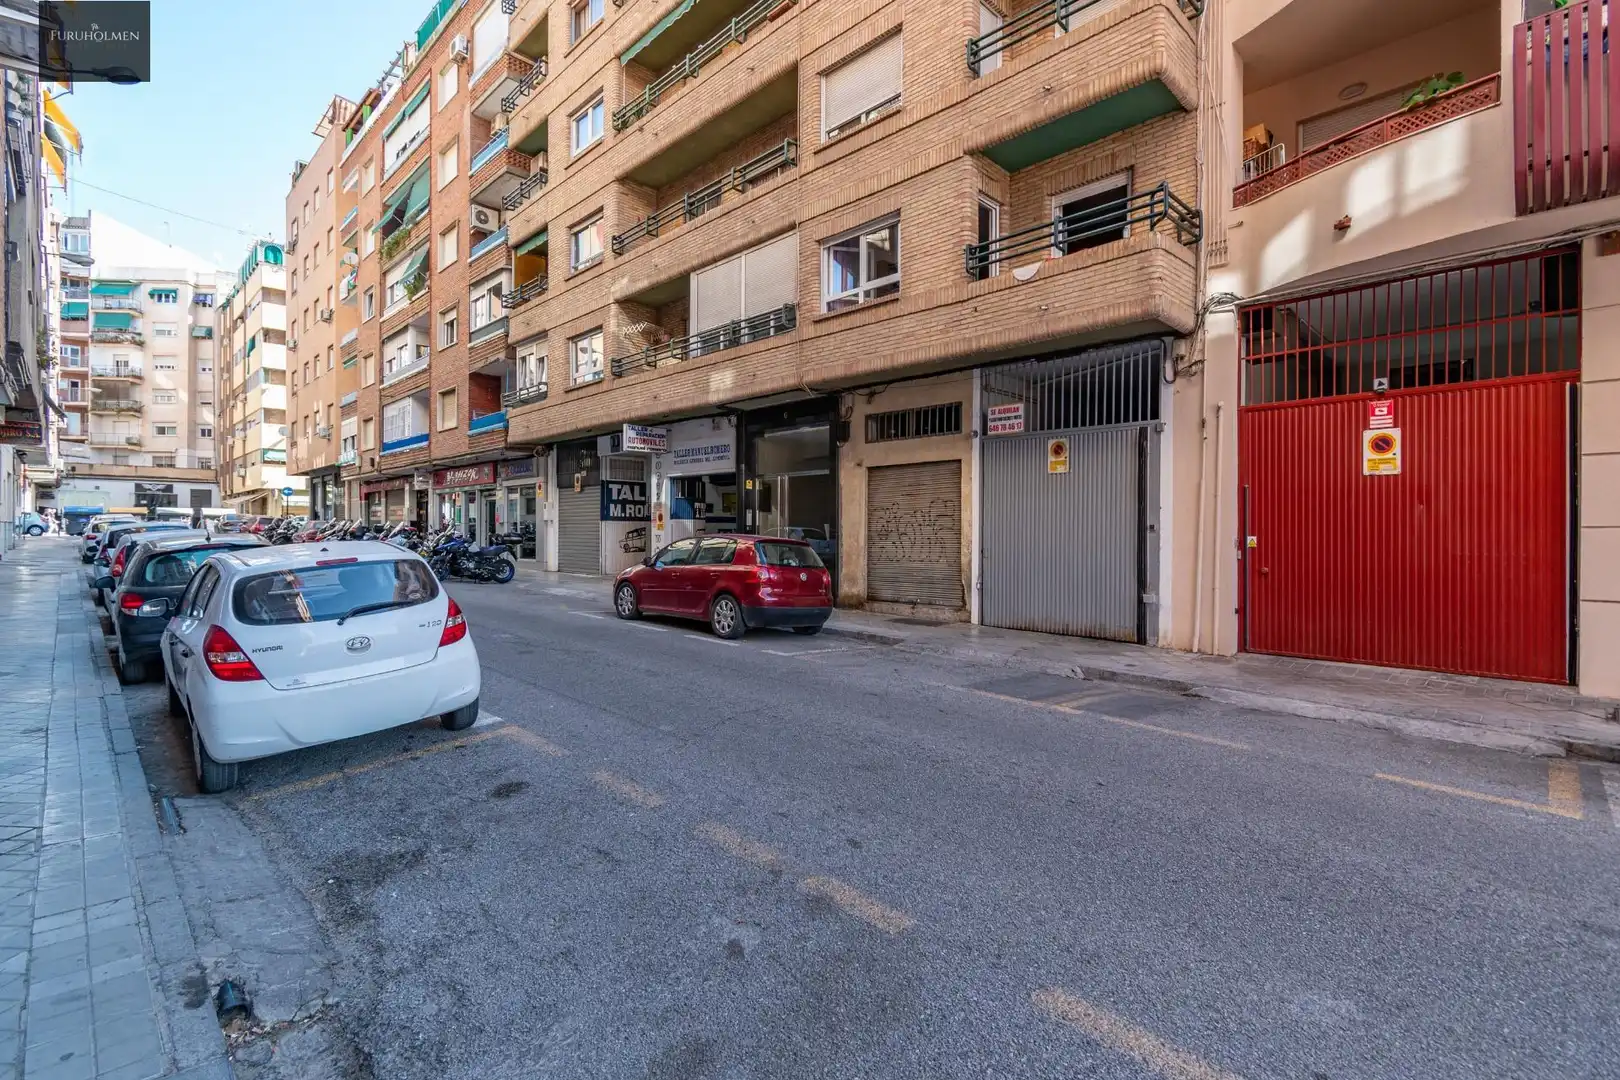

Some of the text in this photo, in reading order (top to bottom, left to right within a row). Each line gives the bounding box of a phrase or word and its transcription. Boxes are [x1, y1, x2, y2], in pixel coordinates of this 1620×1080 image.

[628, 425, 648, 433] TALLER
[628, 437, 666, 447] AUTOMOVILES
[609, 484, 645, 501] TAL
[252, 645, 283, 653] HYUNDAI
